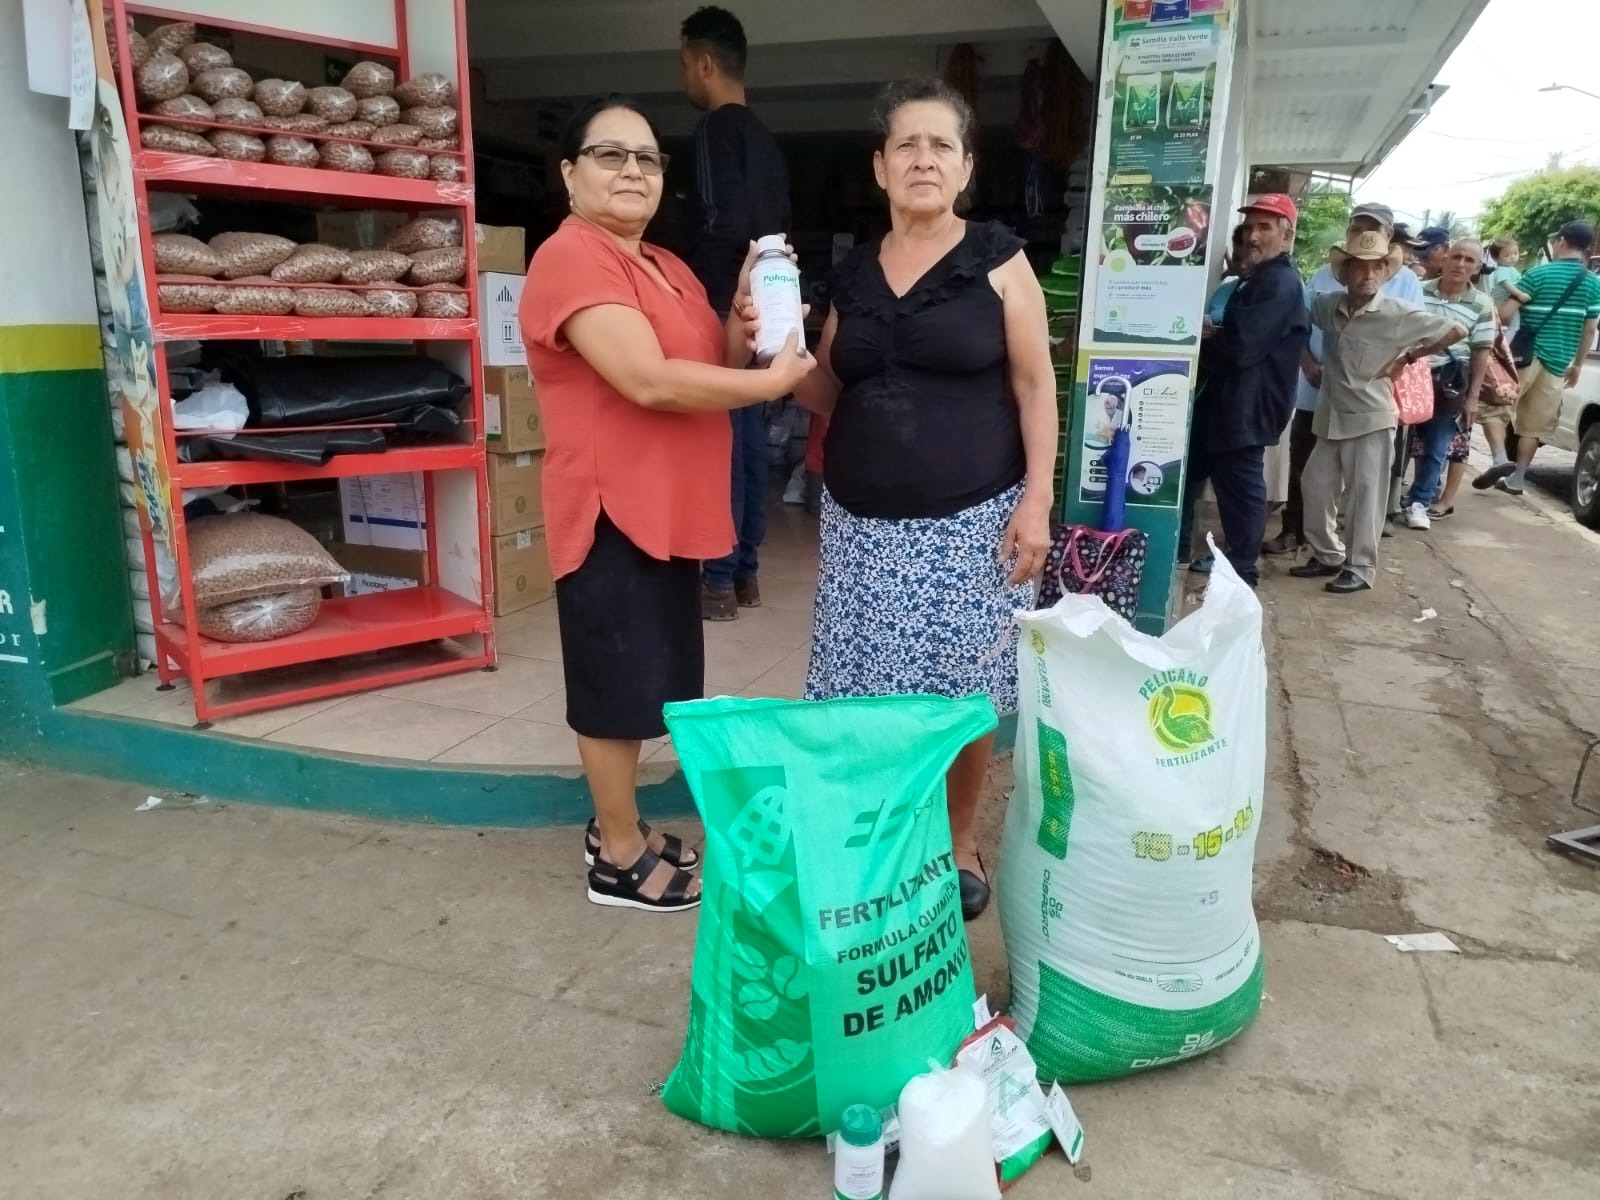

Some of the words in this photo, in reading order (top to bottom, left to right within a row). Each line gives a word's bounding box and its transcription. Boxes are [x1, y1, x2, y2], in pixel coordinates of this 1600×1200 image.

[1141, 37, 1167, 45] Semilla
[1168, 34, 1186, 42] Valle
[1187, 33, 1209, 41] Verde
[1113, 210, 1135, 222] más
[1135, 211, 1170, 222] chilero
[1138, 668, 1209, 701] PELICANO
[1155, 738, 1230, 768] FERTILIZANTE
[837, 923, 919, 965] FORMULA
[918, 881, 958, 929] QUIMICA
[856, 909, 958, 996] SULFATO
[843, 1003, 885, 1038] DE
